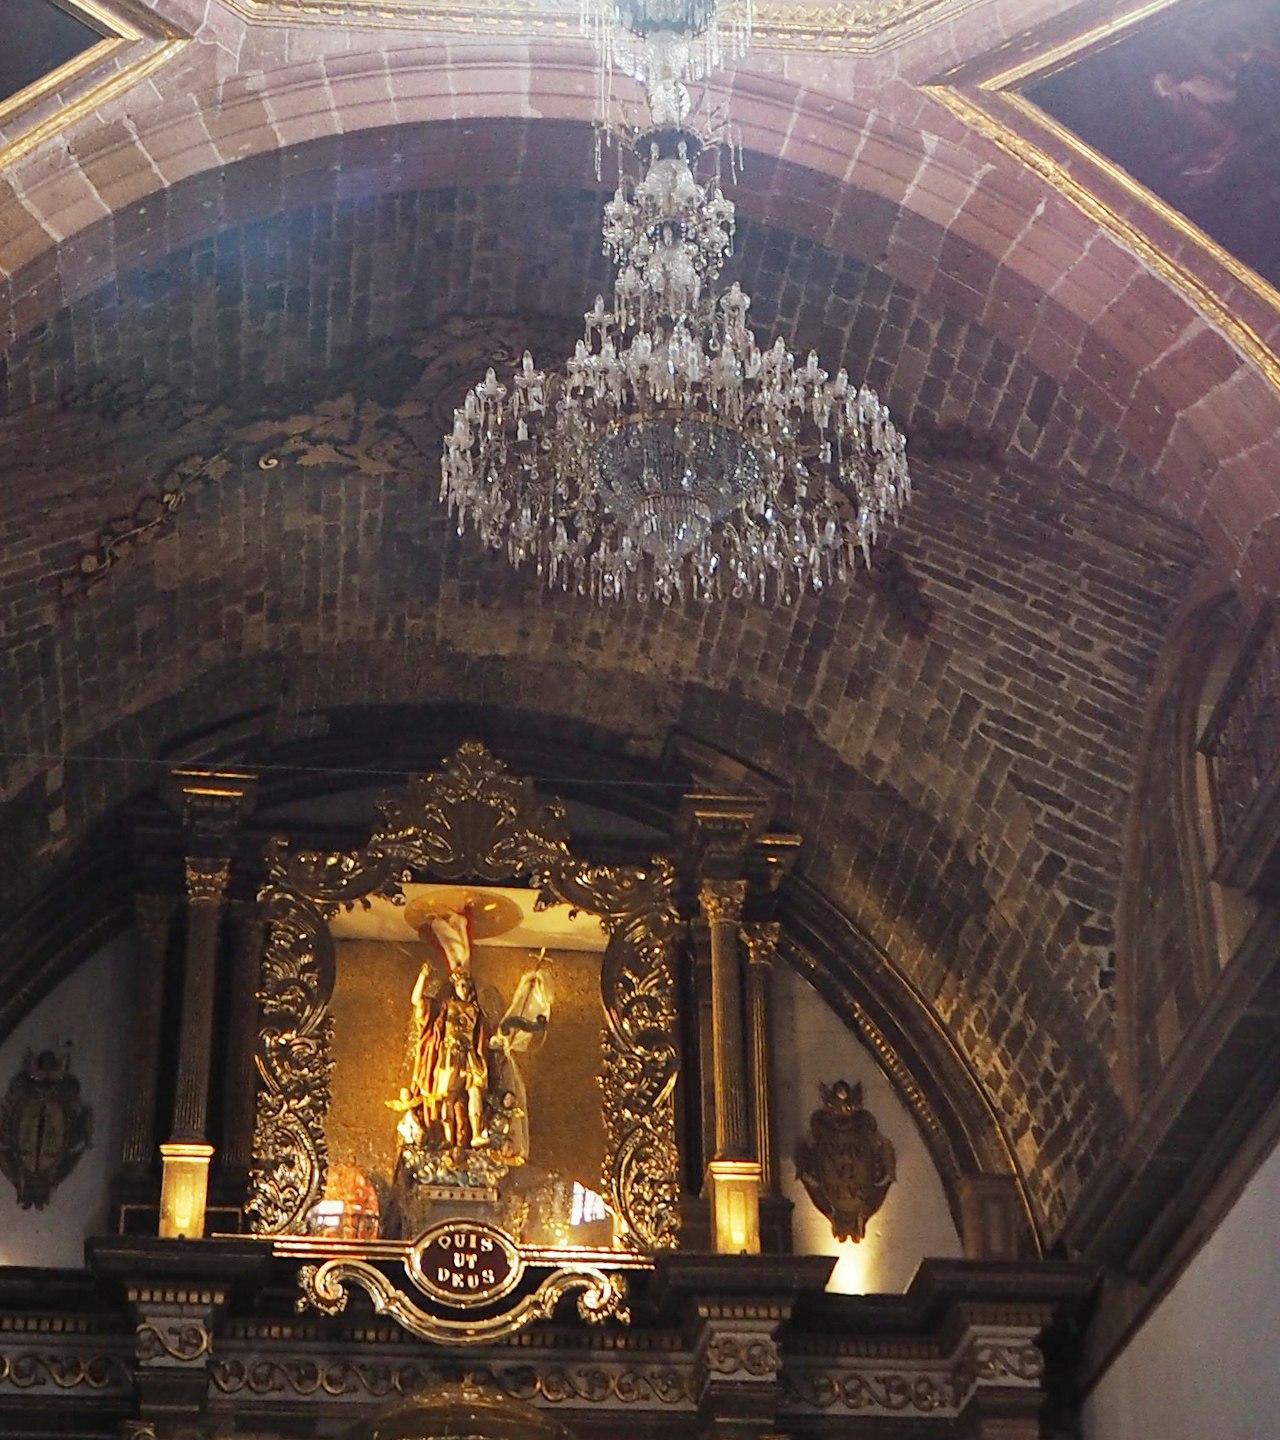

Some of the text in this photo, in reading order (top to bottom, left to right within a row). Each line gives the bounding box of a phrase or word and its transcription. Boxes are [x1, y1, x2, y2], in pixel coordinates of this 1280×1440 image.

[438, 1233, 494, 1252] QUIS
[453, 1252, 478, 1270] UT
[437, 1267, 495, 1289] DEUS
